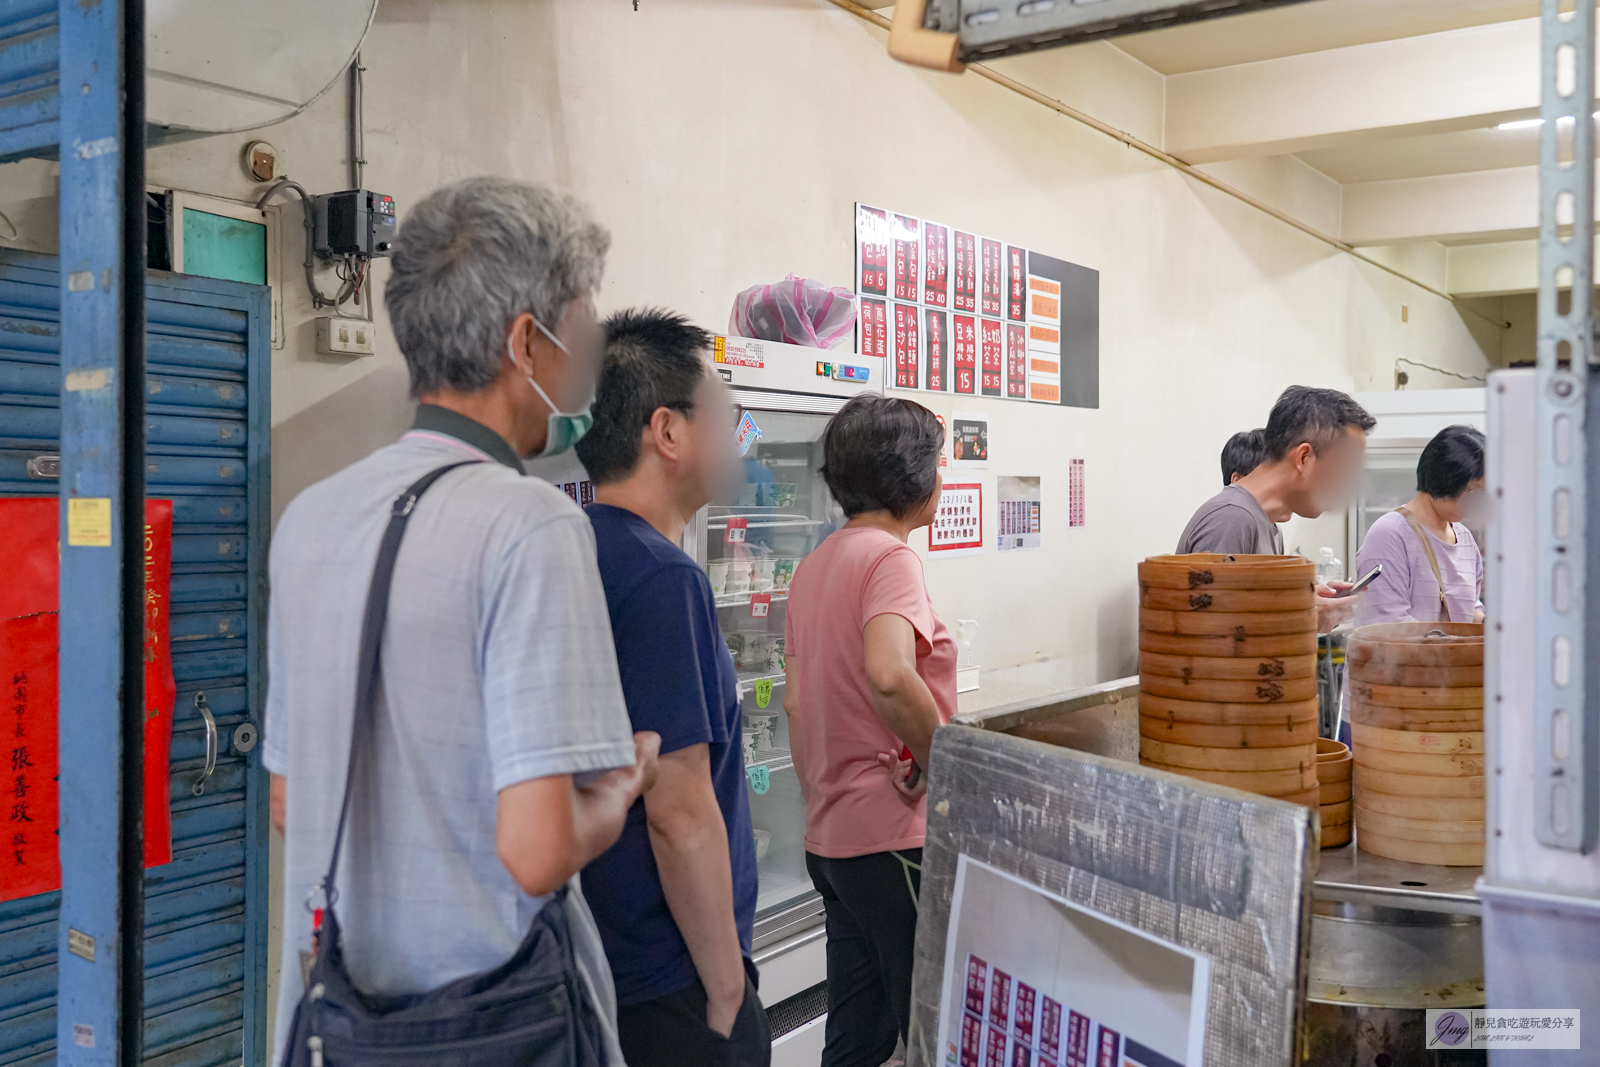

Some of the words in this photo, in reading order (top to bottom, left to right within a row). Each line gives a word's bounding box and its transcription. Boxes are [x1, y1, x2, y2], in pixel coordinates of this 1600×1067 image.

[908, 226, 918, 277] 菜包
[864, 273, 874, 285] 15
[877, 272, 884, 287] 6
[1011, 252, 1021, 297] 酸辣湯
[896, 284, 905, 296] 15
[907, 286, 916, 299] 15
[925, 290, 935, 302] 25
[936, 291, 946, 304] 40
[955, 295, 965, 305] 25
[965, 297, 974, 309] 35
[982, 298, 991, 311] 35
[991, 300, 1000, 312] 35
[1011, 303, 1020, 316] 35
[862, 304, 872, 353] 荷包蛋
[896, 310, 906, 365] 豆沙包
[907, 314, 917, 365] 小饅頭
[955, 322, 965, 362] 豆漿
[966, 324, 975, 363] 米漿
[982, 326, 991, 365] 紅茶
[991, 328, 1001, 367] 奶茶
[1008, 330, 1016, 376] 冬瓜茶
[898, 373, 906, 385] 15
[909, 375, 914, 385] 5
[931, 375, 940, 387] 25
[959, 371, 970, 389] 15
[983, 374, 990, 386] 15
[993, 375, 1000, 387] 15
[1009, 383, 1016, 393] 15
[939, 494, 973, 504] 12/3/1起
[12, 671, 28, 738] 桃園市長
[10, 746, 34, 823] 張善政
